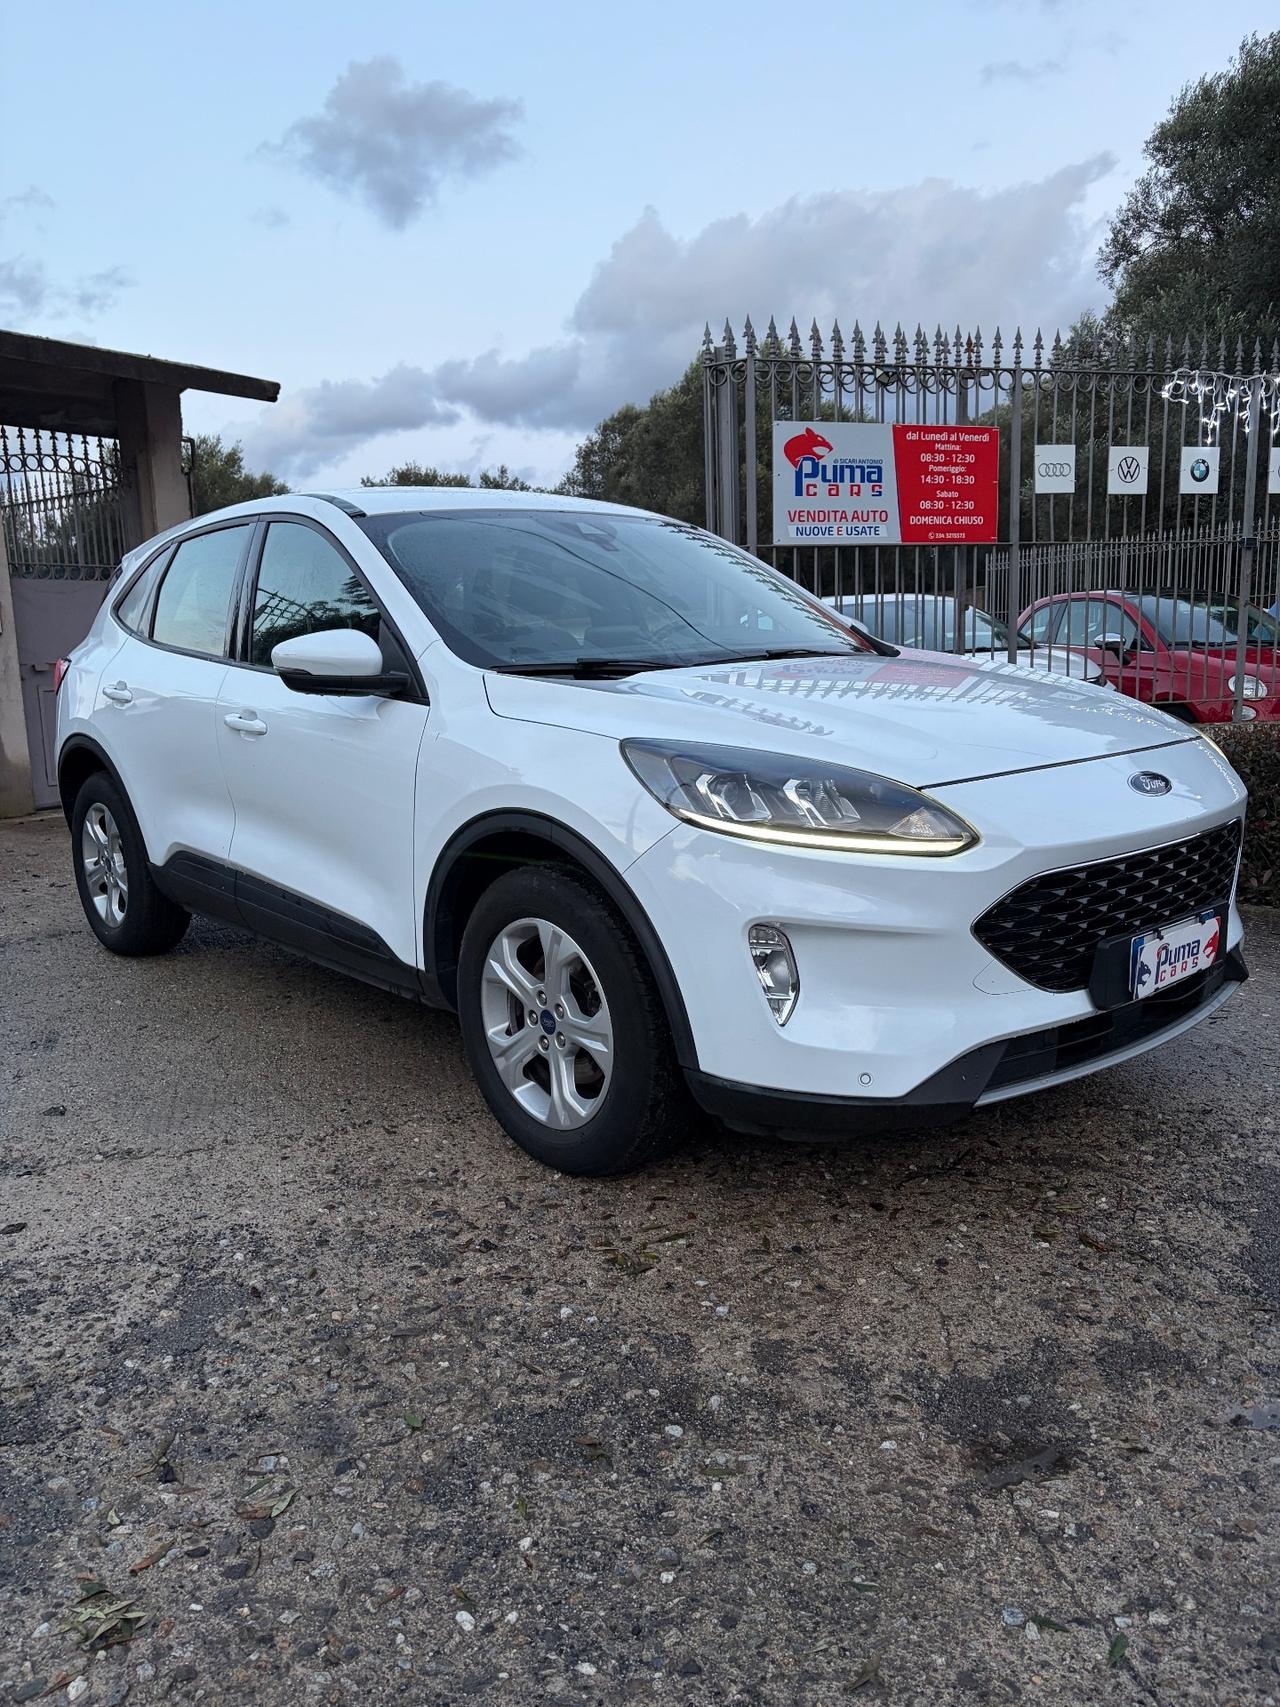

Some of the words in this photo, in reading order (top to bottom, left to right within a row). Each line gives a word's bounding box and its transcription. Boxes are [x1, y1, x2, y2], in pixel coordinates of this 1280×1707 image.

[906, 431, 919, 440] dal
[920, 431, 948, 441] Lunedì
[949, 432, 957, 440] al
[935, 443, 962, 451] Mattina:
[920, 453, 945, 462] 08:30
[952, 453, 976, 463] 12:30
[928, 464, 967, 473] Pomeriggio:
[794, 456, 883, 497] Puma
[920, 475, 945, 484] 14:30
[952, 475, 975, 484] 18:30
[936, 490, 959, 498] Sabato
[920, 500, 944, 509] 08:30
[951, 500, 975, 509] 12:30
[787, 510, 849, 522] VENDITA
[851, 510, 888, 522] AUTO
[909, 516, 952, 525] DOMENICA
[954, 516, 984, 525] CHIUSO
[796, 526, 834, 536] NUOVE
[837, 526, 843, 535] E
[846, 526, 880, 536] USATE
[1155, 939, 1201, 985] Puma
